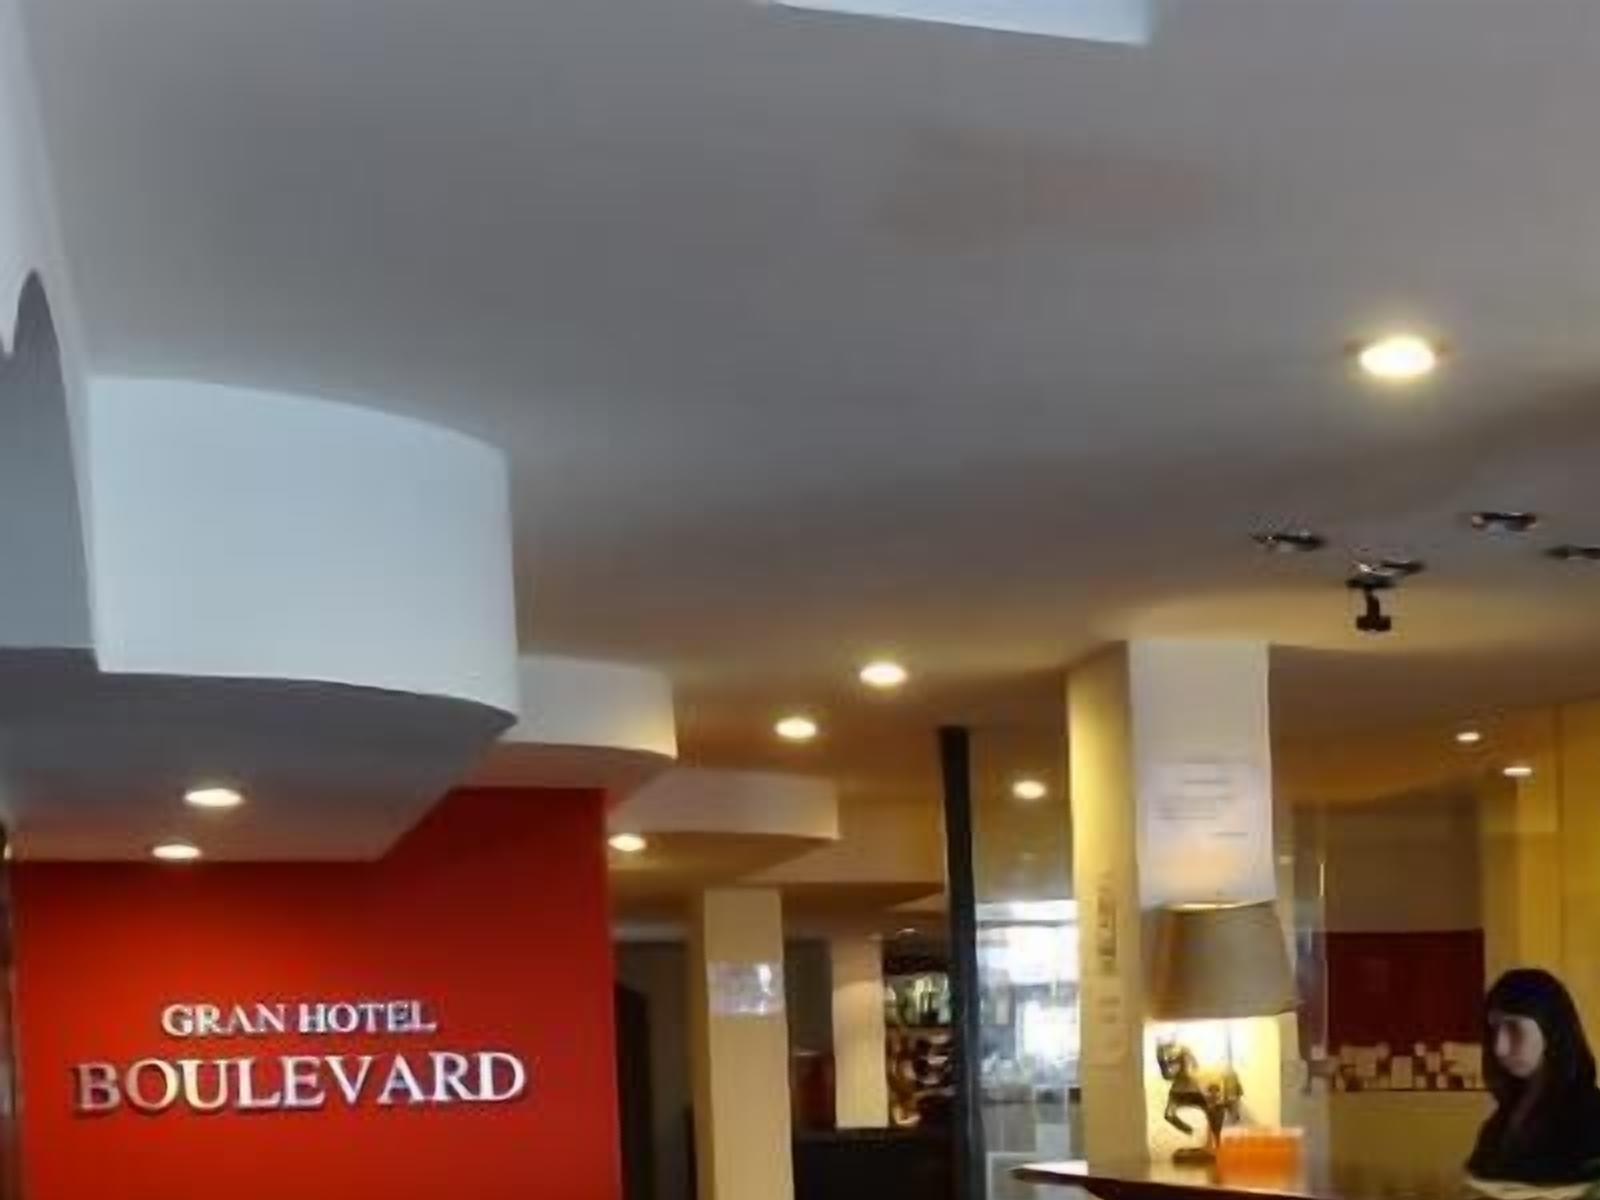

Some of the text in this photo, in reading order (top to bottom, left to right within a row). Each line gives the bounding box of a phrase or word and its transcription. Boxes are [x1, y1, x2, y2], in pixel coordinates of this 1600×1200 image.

[160, 1000, 437, 1036] GRAN HOTEL
[74, 1051, 526, 1112] BOULEVARD
